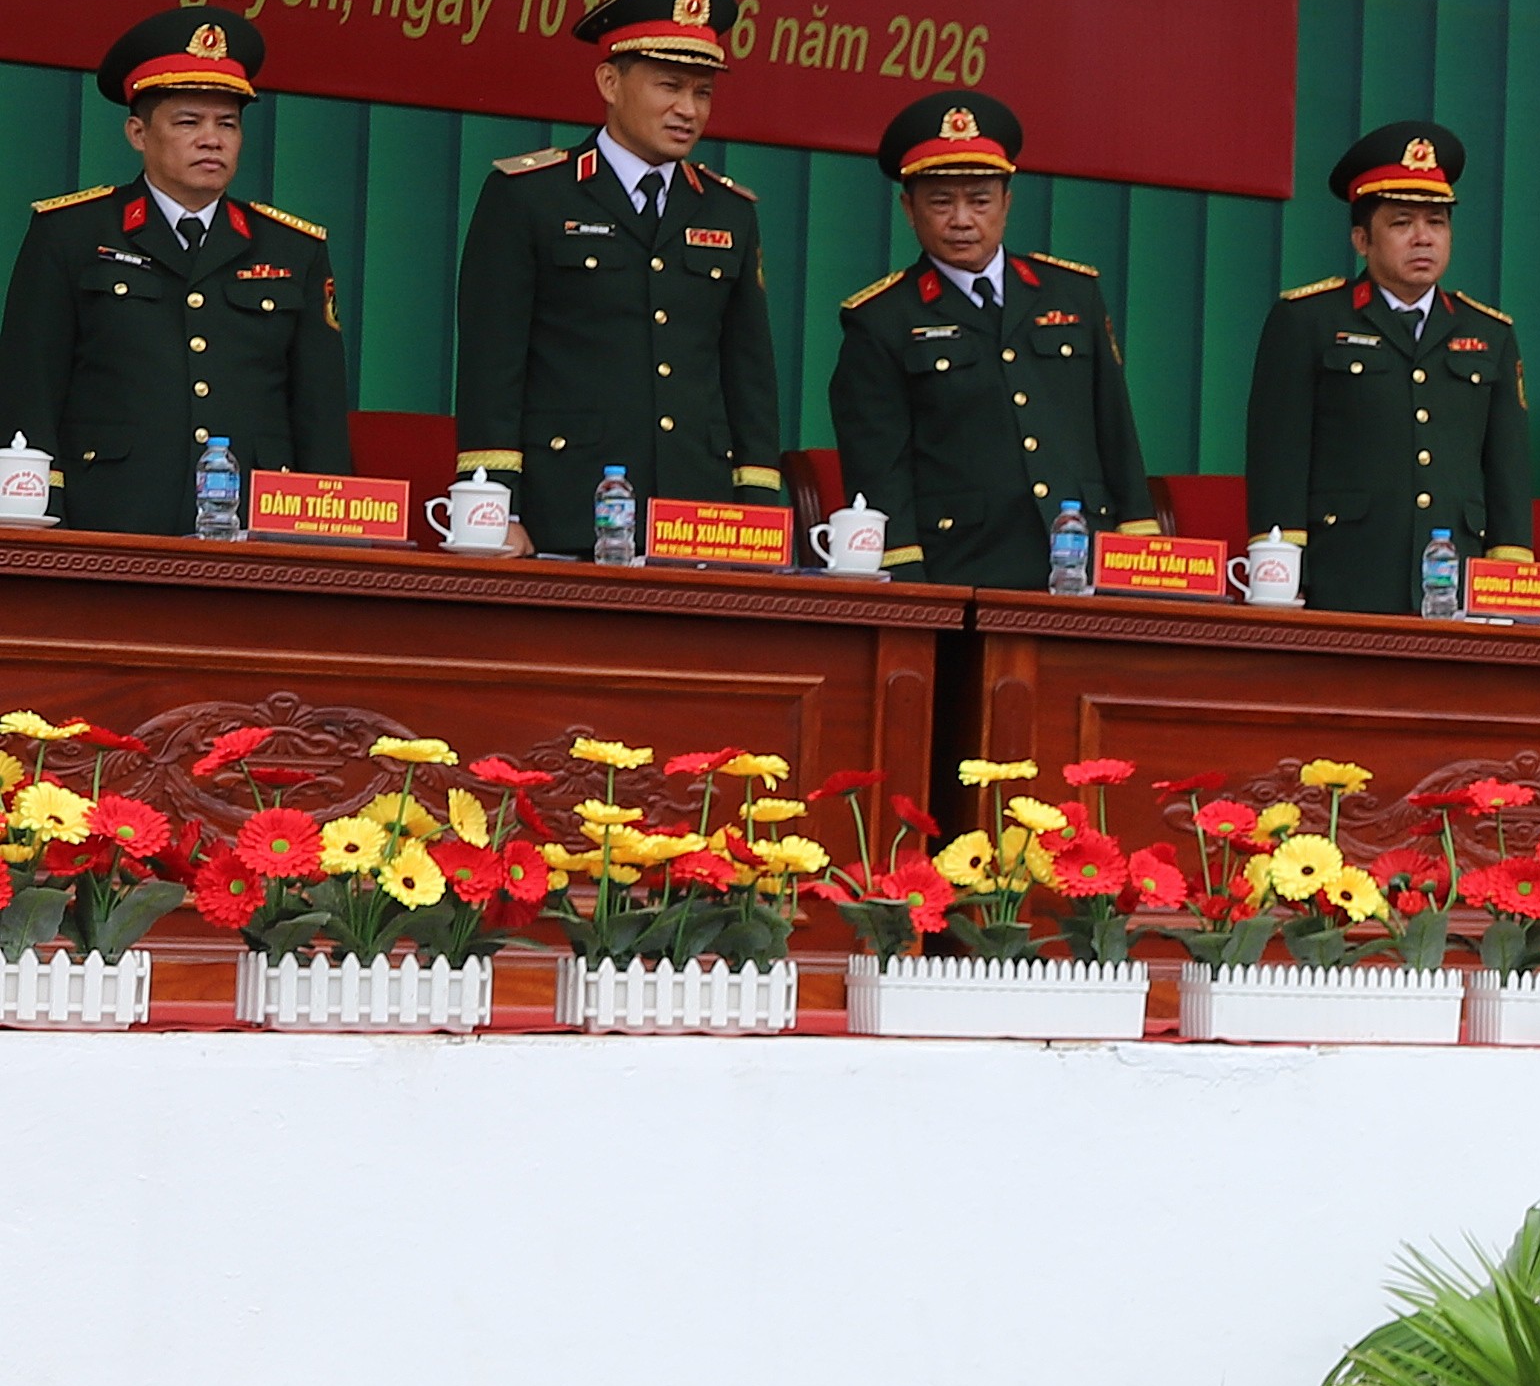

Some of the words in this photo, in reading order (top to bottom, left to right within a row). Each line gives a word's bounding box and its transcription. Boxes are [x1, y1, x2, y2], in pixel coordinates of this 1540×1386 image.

[769, 4, 869, 71] năm
[879, 15, 989, 86] 2026
[305, 491, 346, 519] TIẾN
[350, 496, 398, 523] DŨNG
